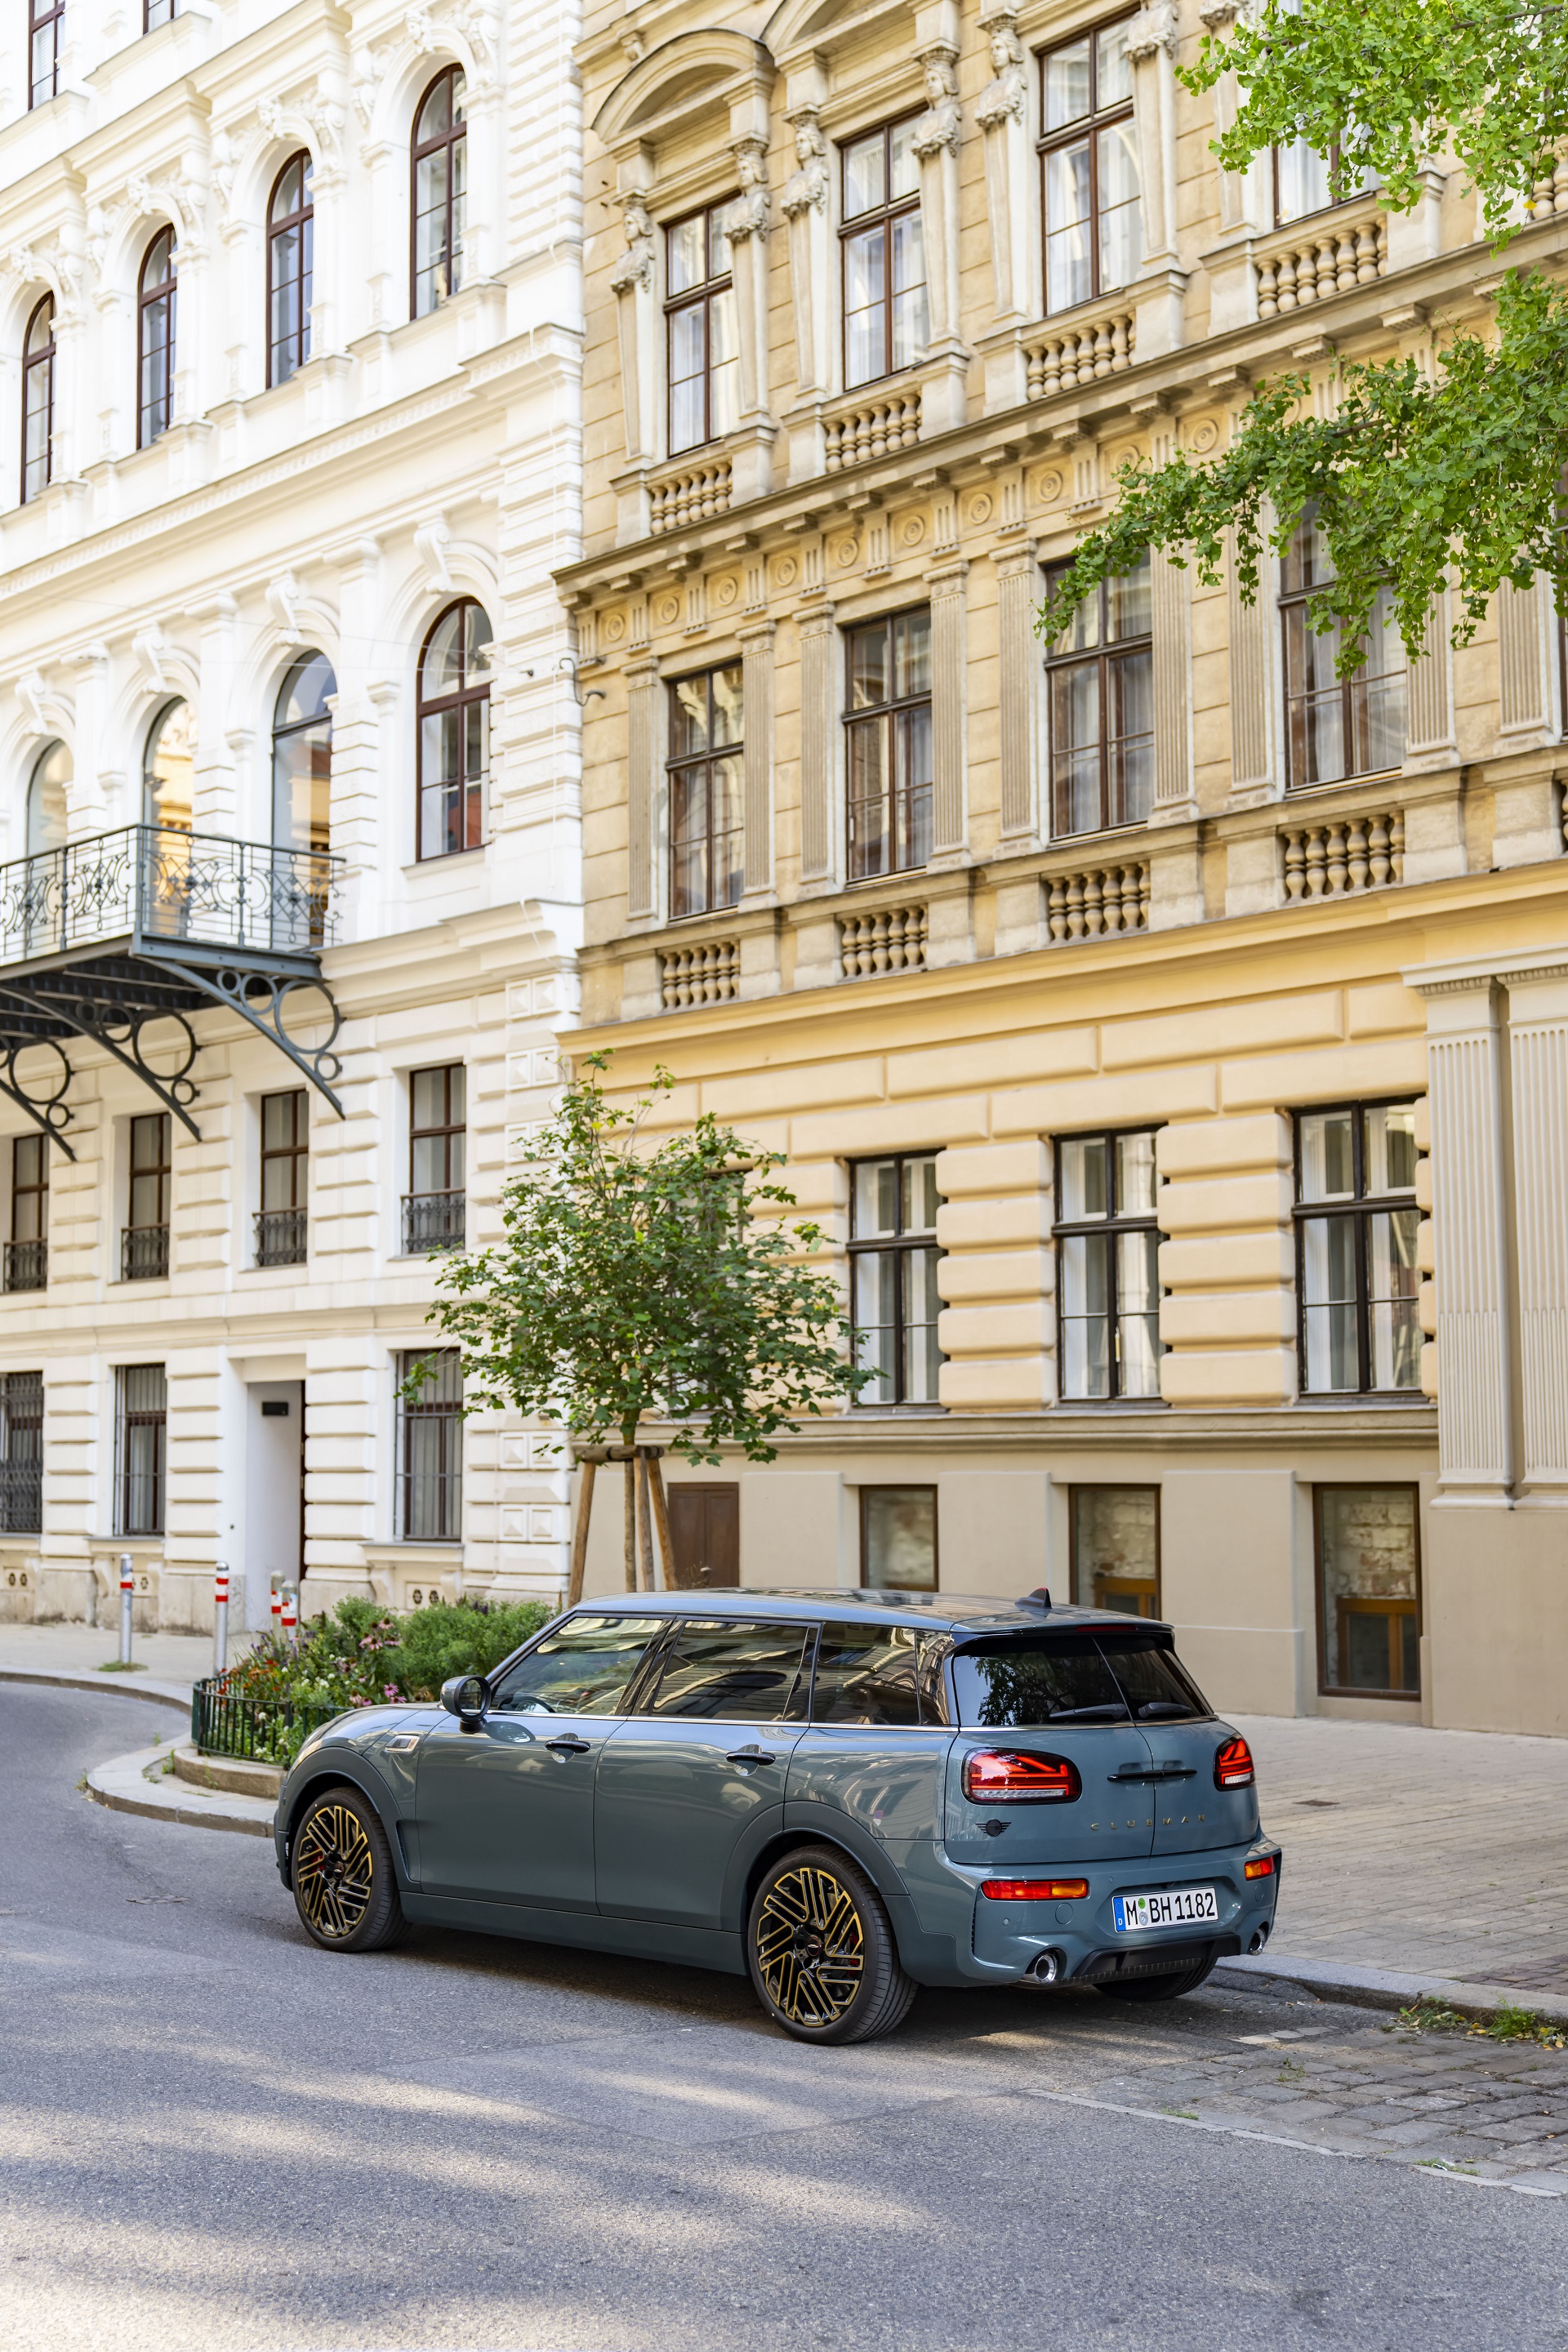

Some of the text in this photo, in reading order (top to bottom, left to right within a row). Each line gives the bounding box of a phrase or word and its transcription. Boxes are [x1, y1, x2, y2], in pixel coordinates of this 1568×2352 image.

[1090, 1815, 1205, 1831] CLUBMAN
[1125, 1900, 1138, 1926] M
[1118, 1918, 1123, 1926] D
